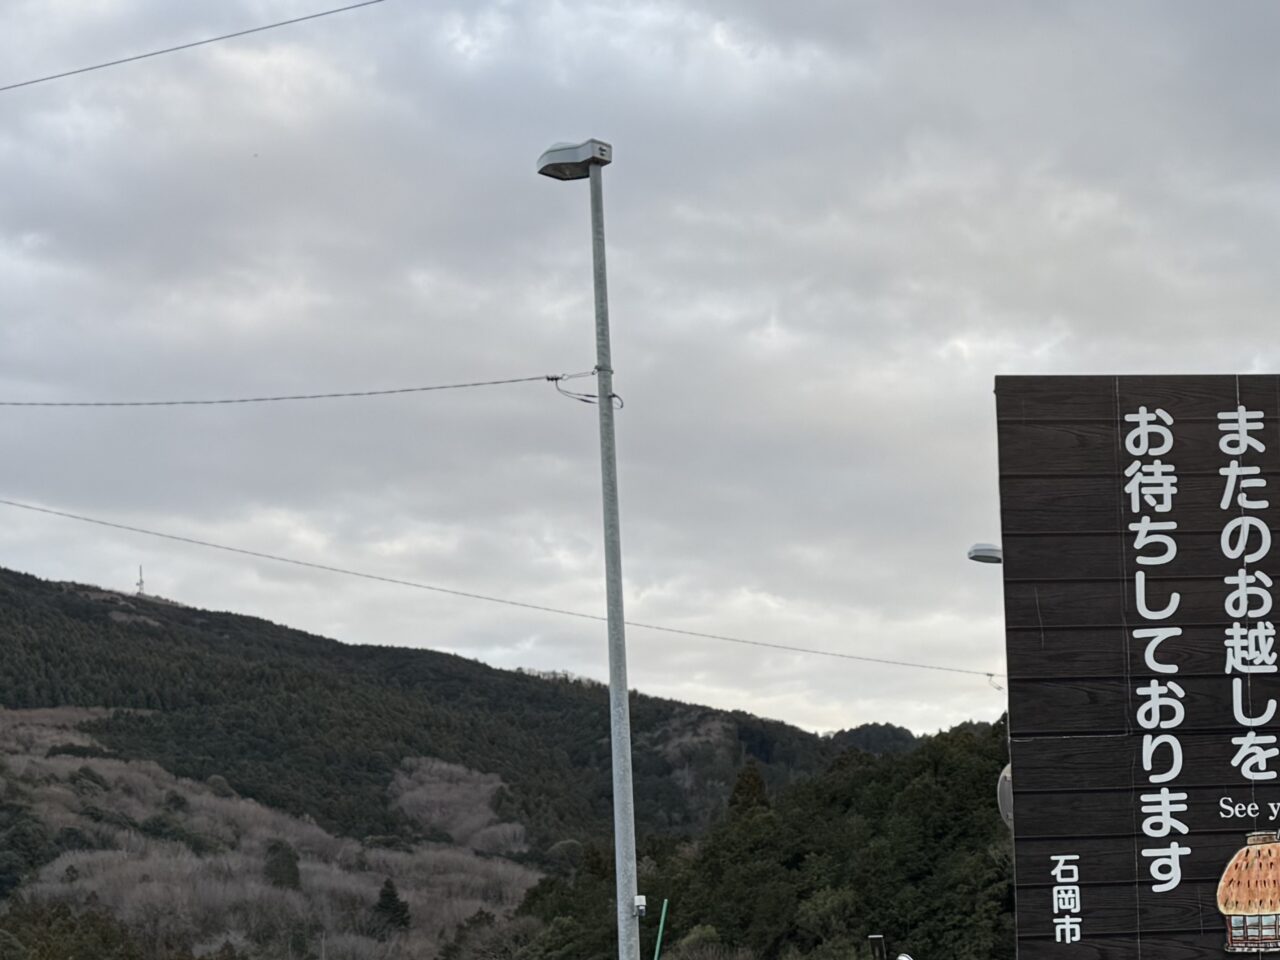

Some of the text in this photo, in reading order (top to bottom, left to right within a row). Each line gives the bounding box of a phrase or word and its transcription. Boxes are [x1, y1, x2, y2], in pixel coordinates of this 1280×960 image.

[1124, 405, 1191, 893] お待ちしております
[1217, 405, 1279, 781] またのお越しを
[1050, 854, 1082, 944] 石岡市
[1219, 796, 1260, 818] See
